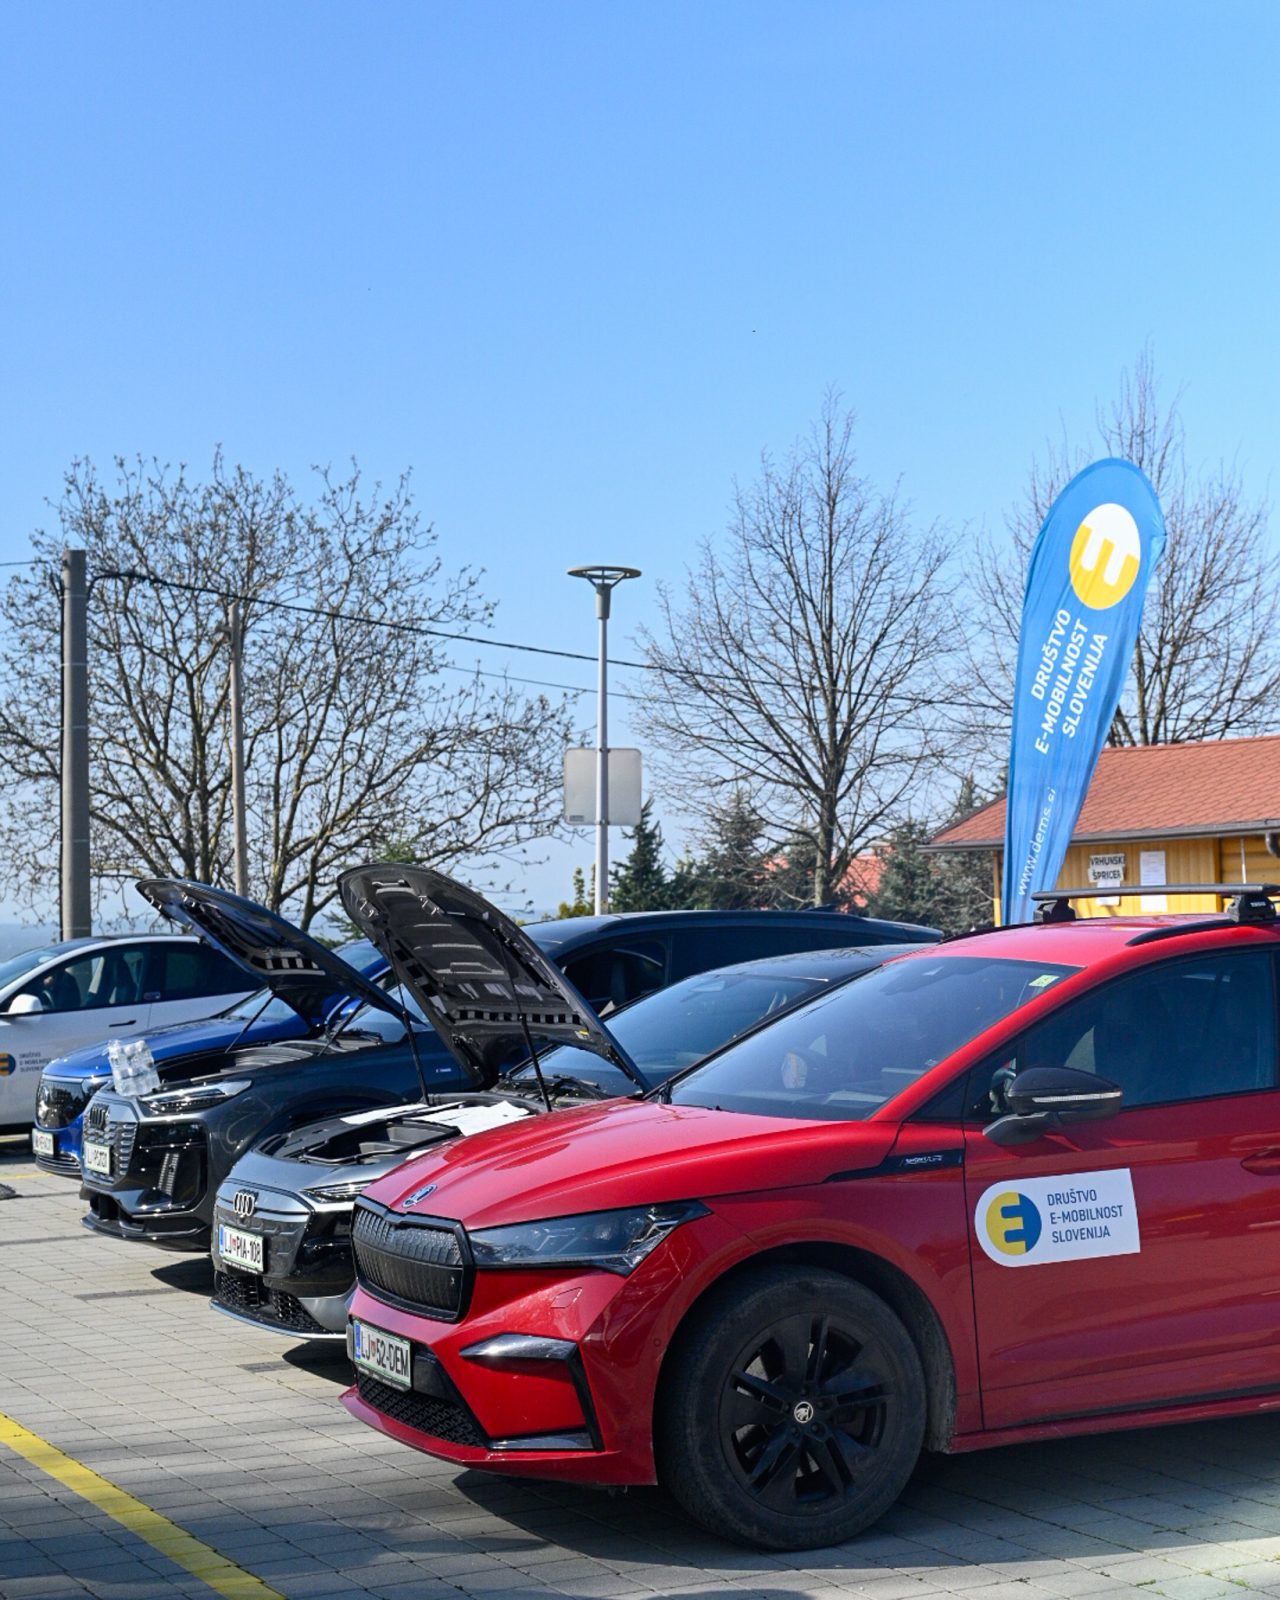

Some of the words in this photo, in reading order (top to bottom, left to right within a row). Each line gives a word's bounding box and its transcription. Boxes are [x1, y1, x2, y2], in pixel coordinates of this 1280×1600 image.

[1031, 609, 1071, 700] DRUŠTVO
[1034, 618, 1089, 755] E-MOBILNOST
[1062, 634, 1109, 738] SLOVENIJA
[1018, 786, 1056, 896] www.dems.si
[1047, 1188, 1097, 1206] DRUŠTVO
[1050, 1205, 1124, 1224] E-MOBILNOST
[1052, 1225, 1111, 1243] SLOVENIJA
[361, 1329, 371, 1361] LJ
